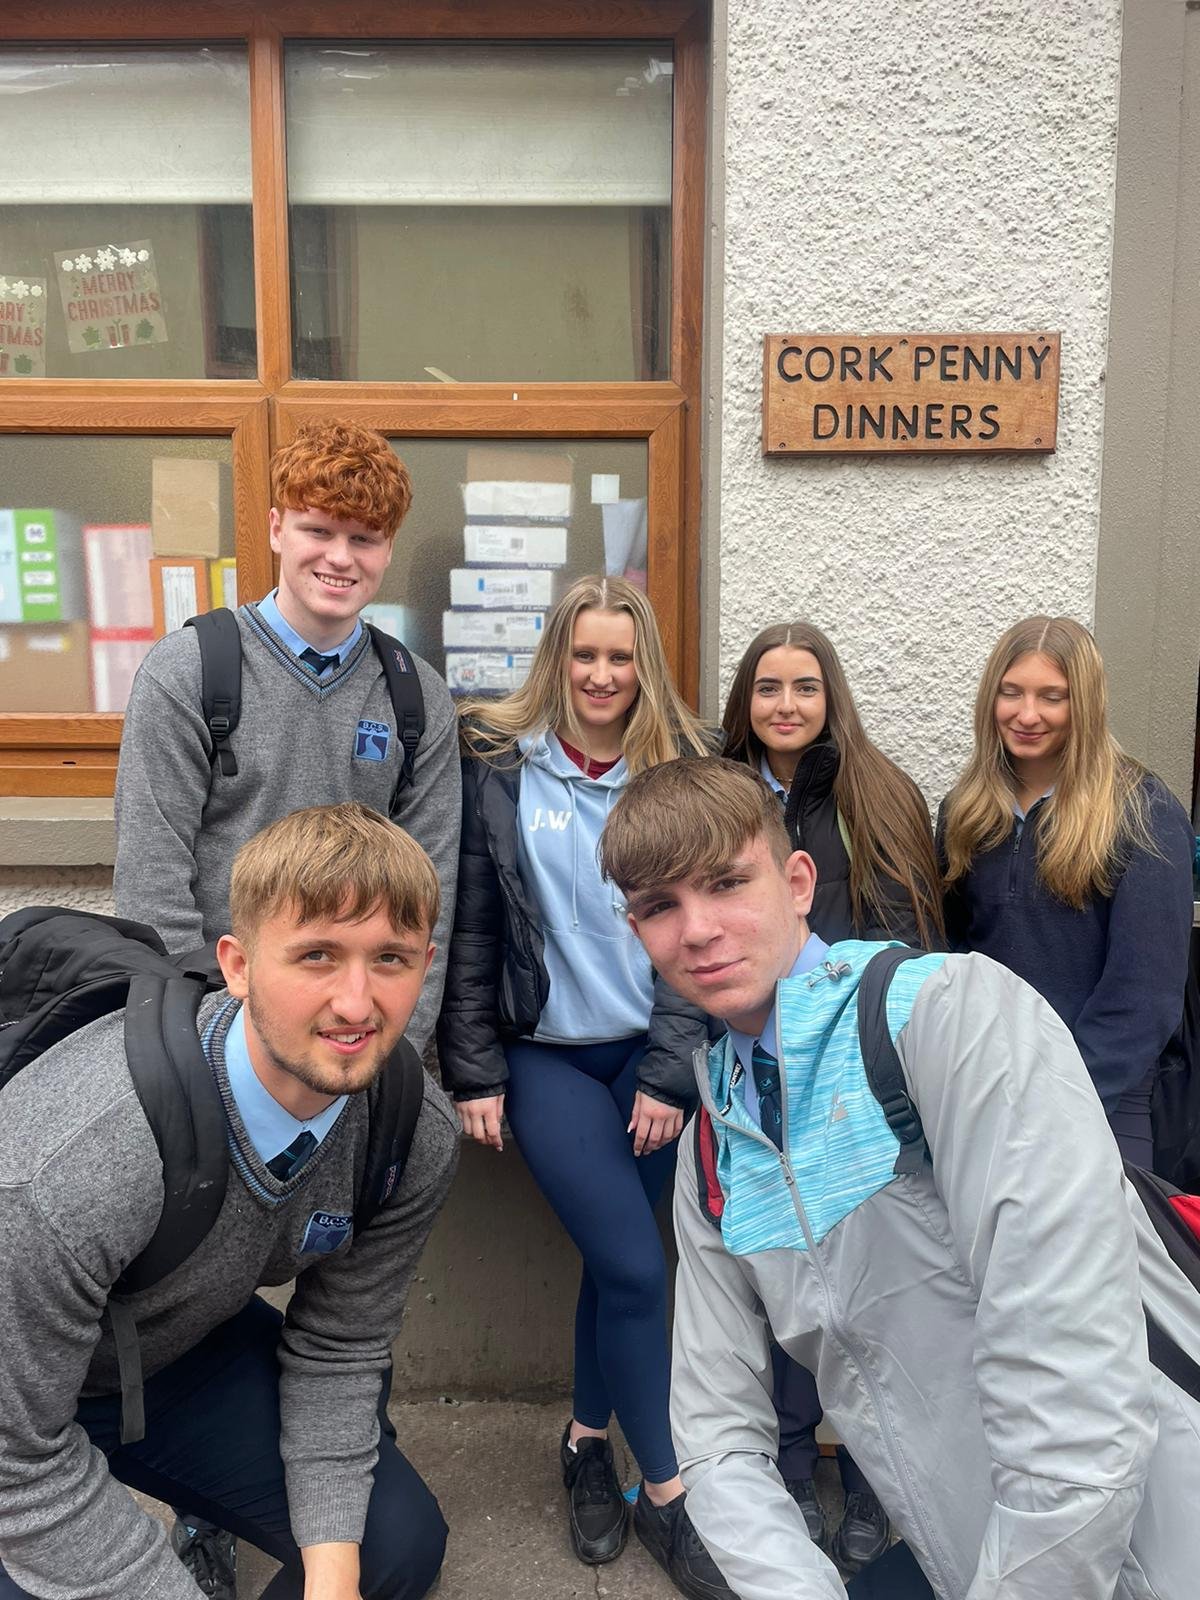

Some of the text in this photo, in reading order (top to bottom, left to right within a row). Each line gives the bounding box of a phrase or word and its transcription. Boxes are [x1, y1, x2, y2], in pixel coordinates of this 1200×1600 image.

[81, 271, 135, 295] MERRY
[67, 292, 160, 321] CHRISTMAS
[777, 345, 1050, 382] CORK PENNY
[813, 404, 1000, 440] DINNERS
